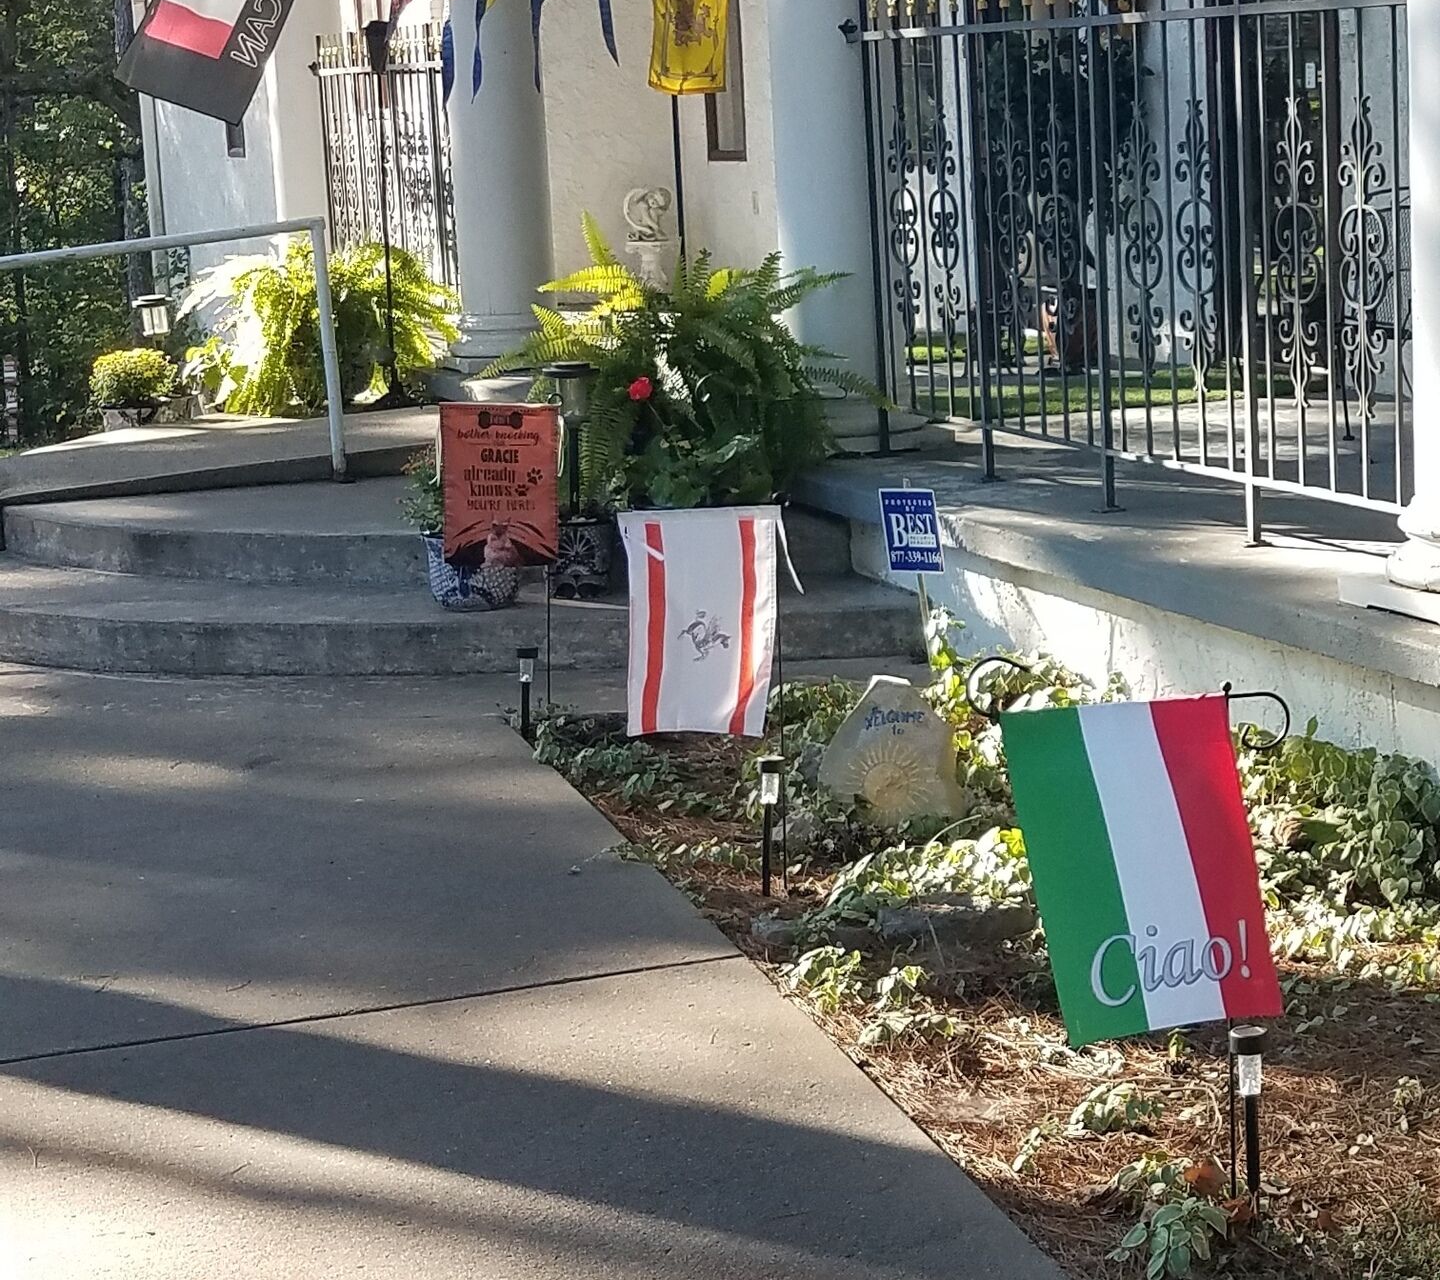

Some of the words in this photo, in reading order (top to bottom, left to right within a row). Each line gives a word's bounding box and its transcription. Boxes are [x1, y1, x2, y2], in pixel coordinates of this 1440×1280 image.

[480, 447, 520, 464] GRACIE
[463, 465, 516, 484] already
[470, 481, 512, 497] knows
[884, 498, 932, 507] PROTECTED
[888, 513, 934, 548] BEST
[890, 550, 942, 564] 877-339-1166
[1090, 919, 1253, 1008] Ciao!
